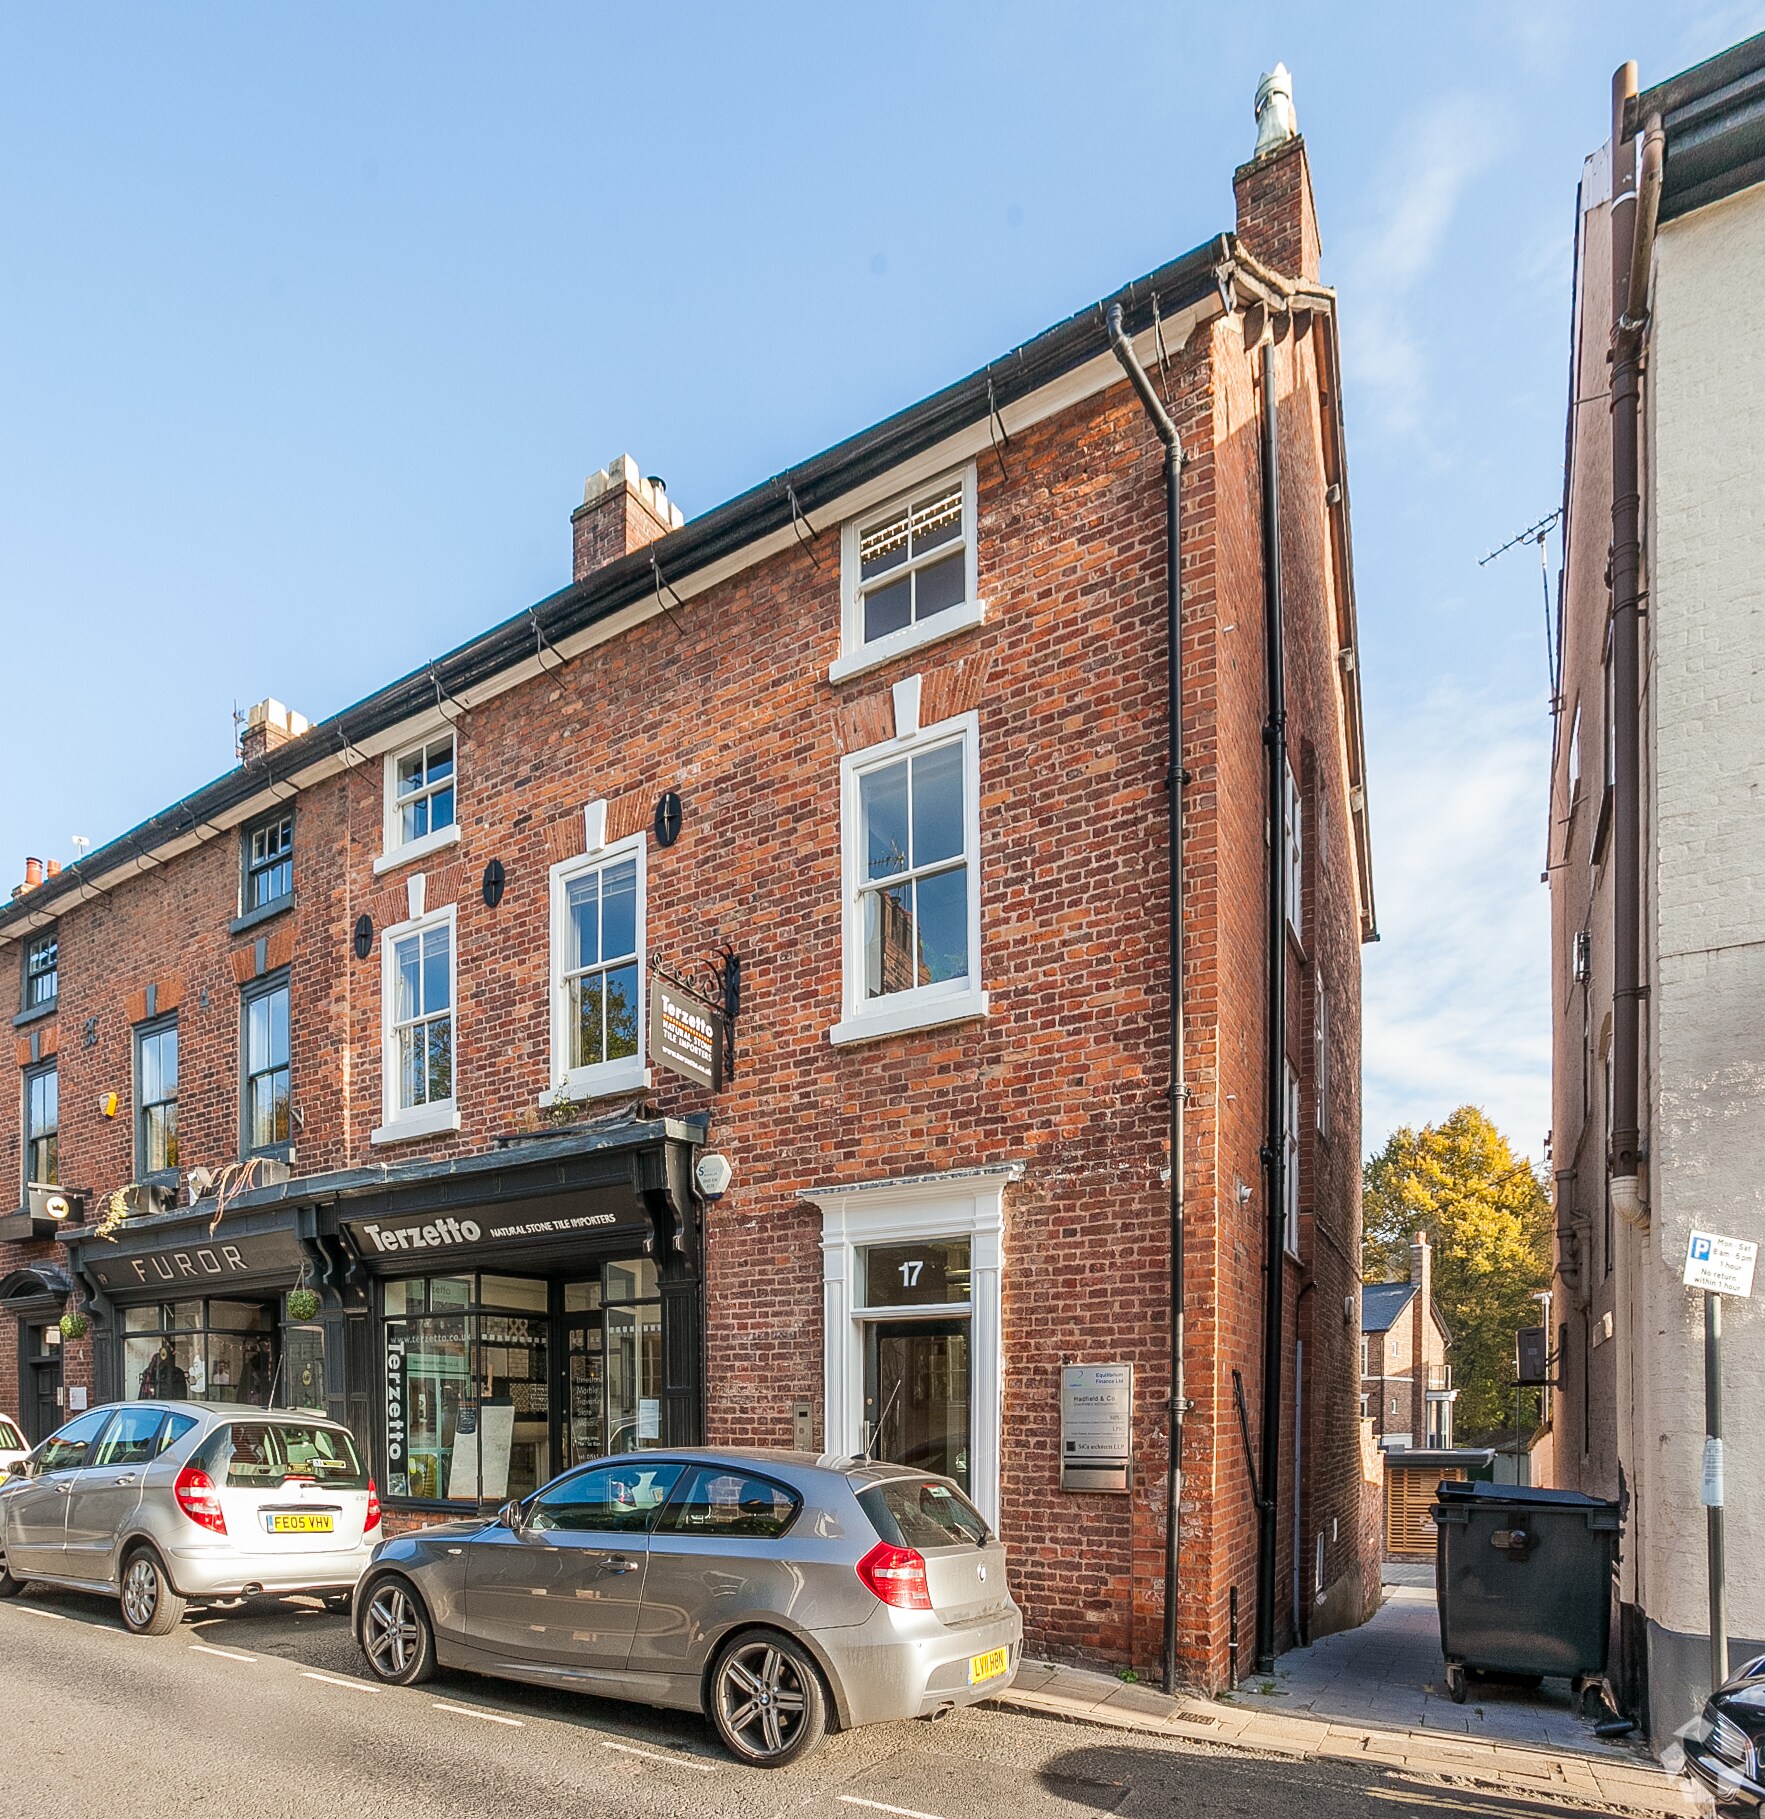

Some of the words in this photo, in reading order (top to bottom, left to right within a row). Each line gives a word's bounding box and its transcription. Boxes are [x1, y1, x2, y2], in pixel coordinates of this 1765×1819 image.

[661, 994, 713, 1038] Terzetto
[663, 1019, 692, 1042] NATURAL
[694, 1036, 713, 1054] STONE
[663, 1028, 677, 1044] TILE
[679, 1037, 713, 1063] IMPORTERS
[363, 1217, 481, 1252] Terzetto
[490, 1224, 527, 1238] NATURAL
[527, 1221, 553, 1234] STONE
[552, 1219, 570, 1231] TILE
[571, 1213, 616, 1229] IMPORTERS
[1694, 1238, 1710, 1259] P
[1718, 1239, 1733, 1248] Mon
[1738, 1243, 1751, 1252] Sat
[131, 1246, 249, 1282] FUROR
[898, 1260, 924, 1287] 17
[1701, 1268, 1711, 1277] No
[1714, 1272, 1736, 1282] return
[1725, 1261, 1742, 1271] hour
[1694, 1277, 1716, 1286] within
[1724, 1282, 1740, 1291] hour
[391, 1334, 472, 1344] www.terzetto.co.uk
[388, 1341, 405, 1460] Terzetto
[275, 1516, 306, 1529] FE05
